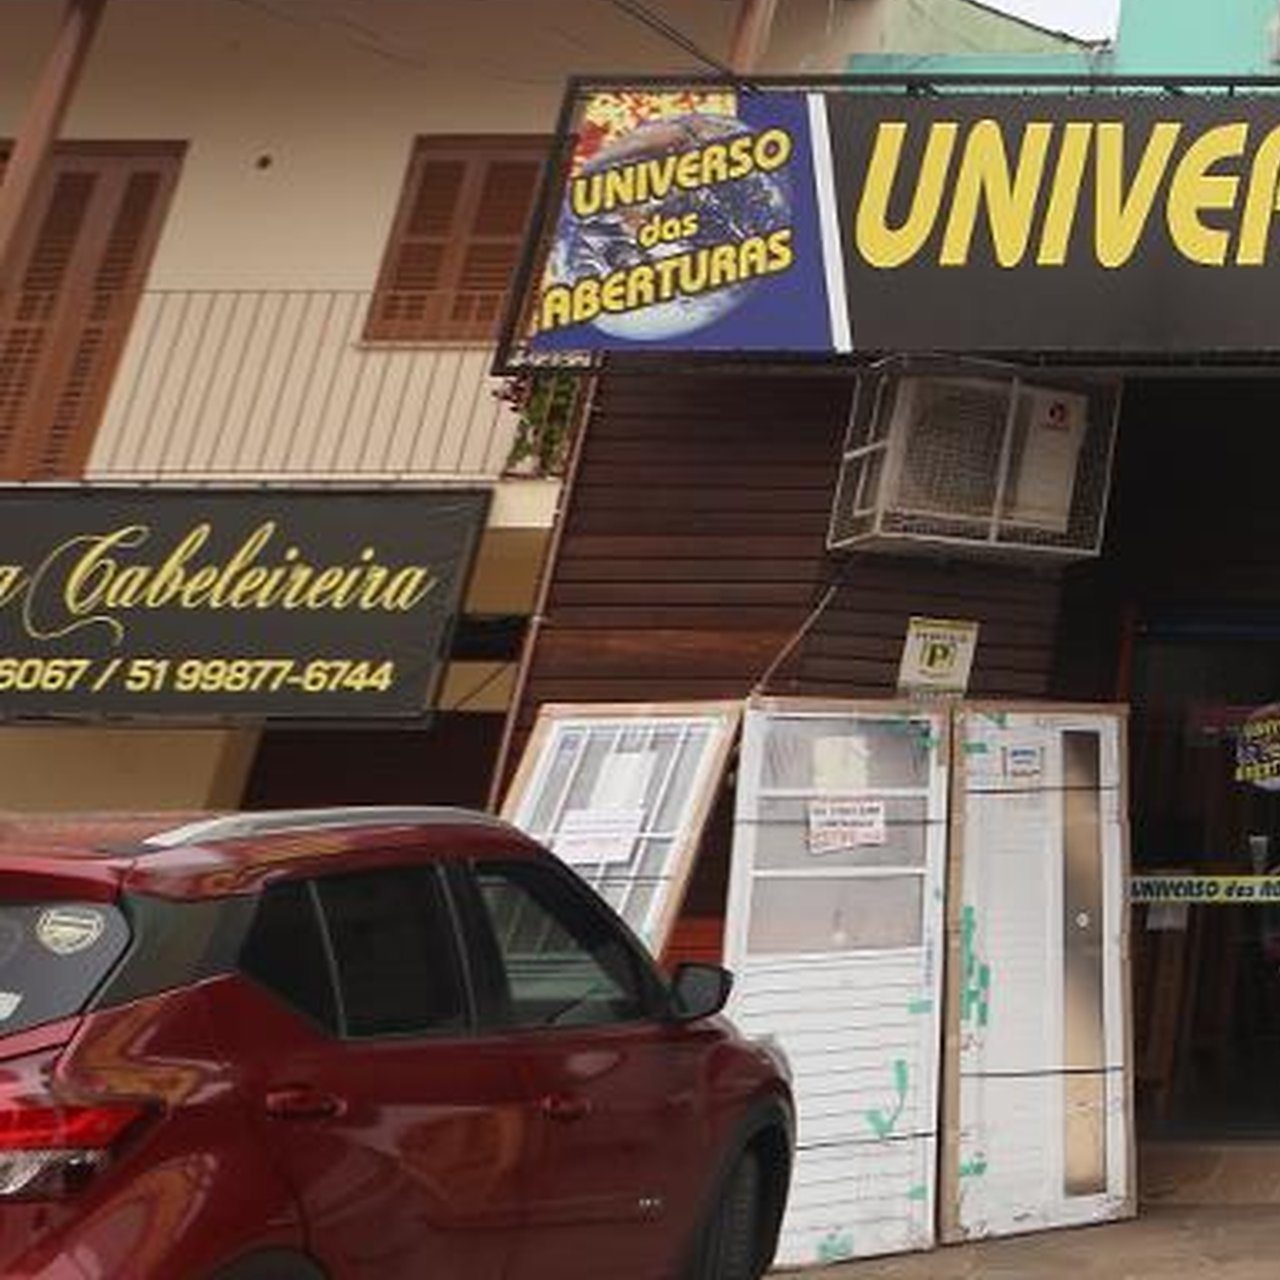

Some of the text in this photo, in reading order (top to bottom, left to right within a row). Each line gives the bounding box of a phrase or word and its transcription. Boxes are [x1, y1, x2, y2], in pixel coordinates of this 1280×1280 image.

[573, 128, 791, 217] UNIVERSO
[638, 211, 699, 249] das
[540, 228, 795, 331] ABERTURAS
[23, 521, 438, 647] Cabeleireira
[125, 659, 170, 693] 51
[175, 658, 396, 693] 99877-6744
